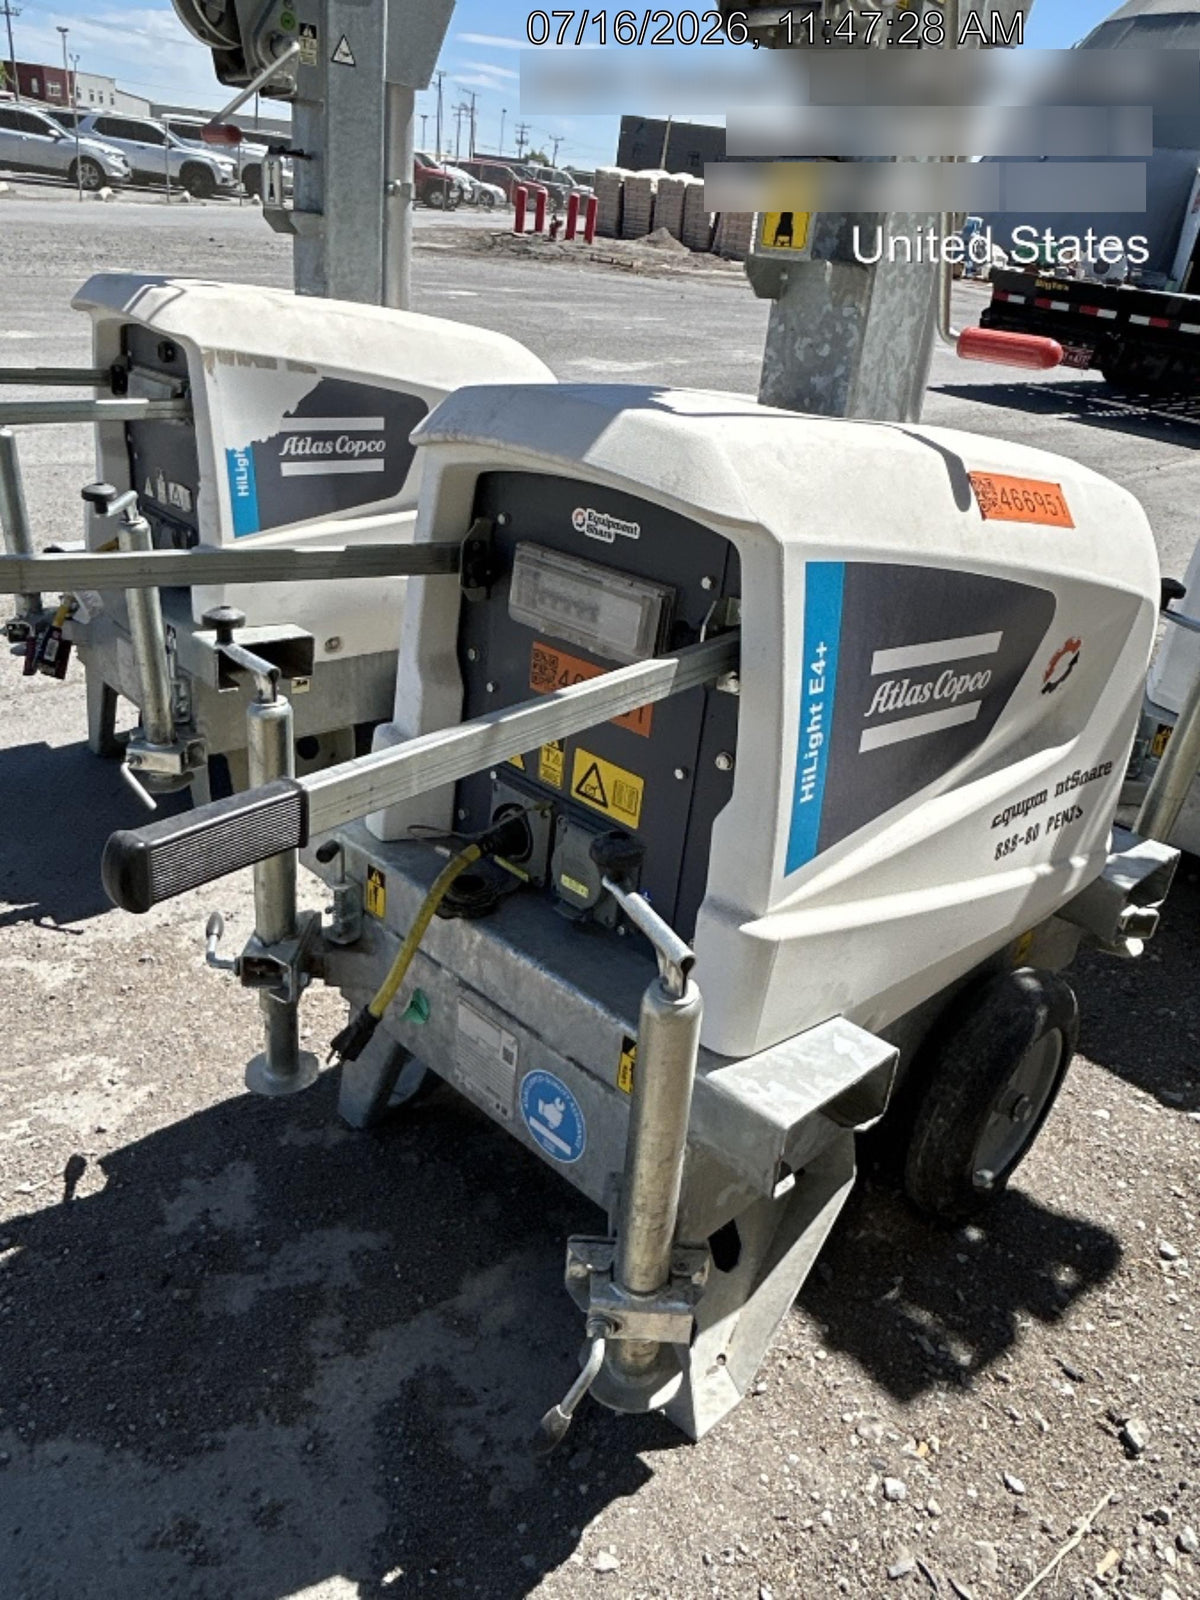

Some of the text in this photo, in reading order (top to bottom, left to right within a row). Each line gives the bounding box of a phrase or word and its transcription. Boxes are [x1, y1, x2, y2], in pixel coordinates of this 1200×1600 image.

[279, 435, 386, 456] Atlas Copco
[233, 450, 249, 497] HiLigh
[1000, 487, 1066, 518] 466951
[863, 669, 992, 717] Atlas Copco
[800, 641, 828, 803] HiLight E4+
